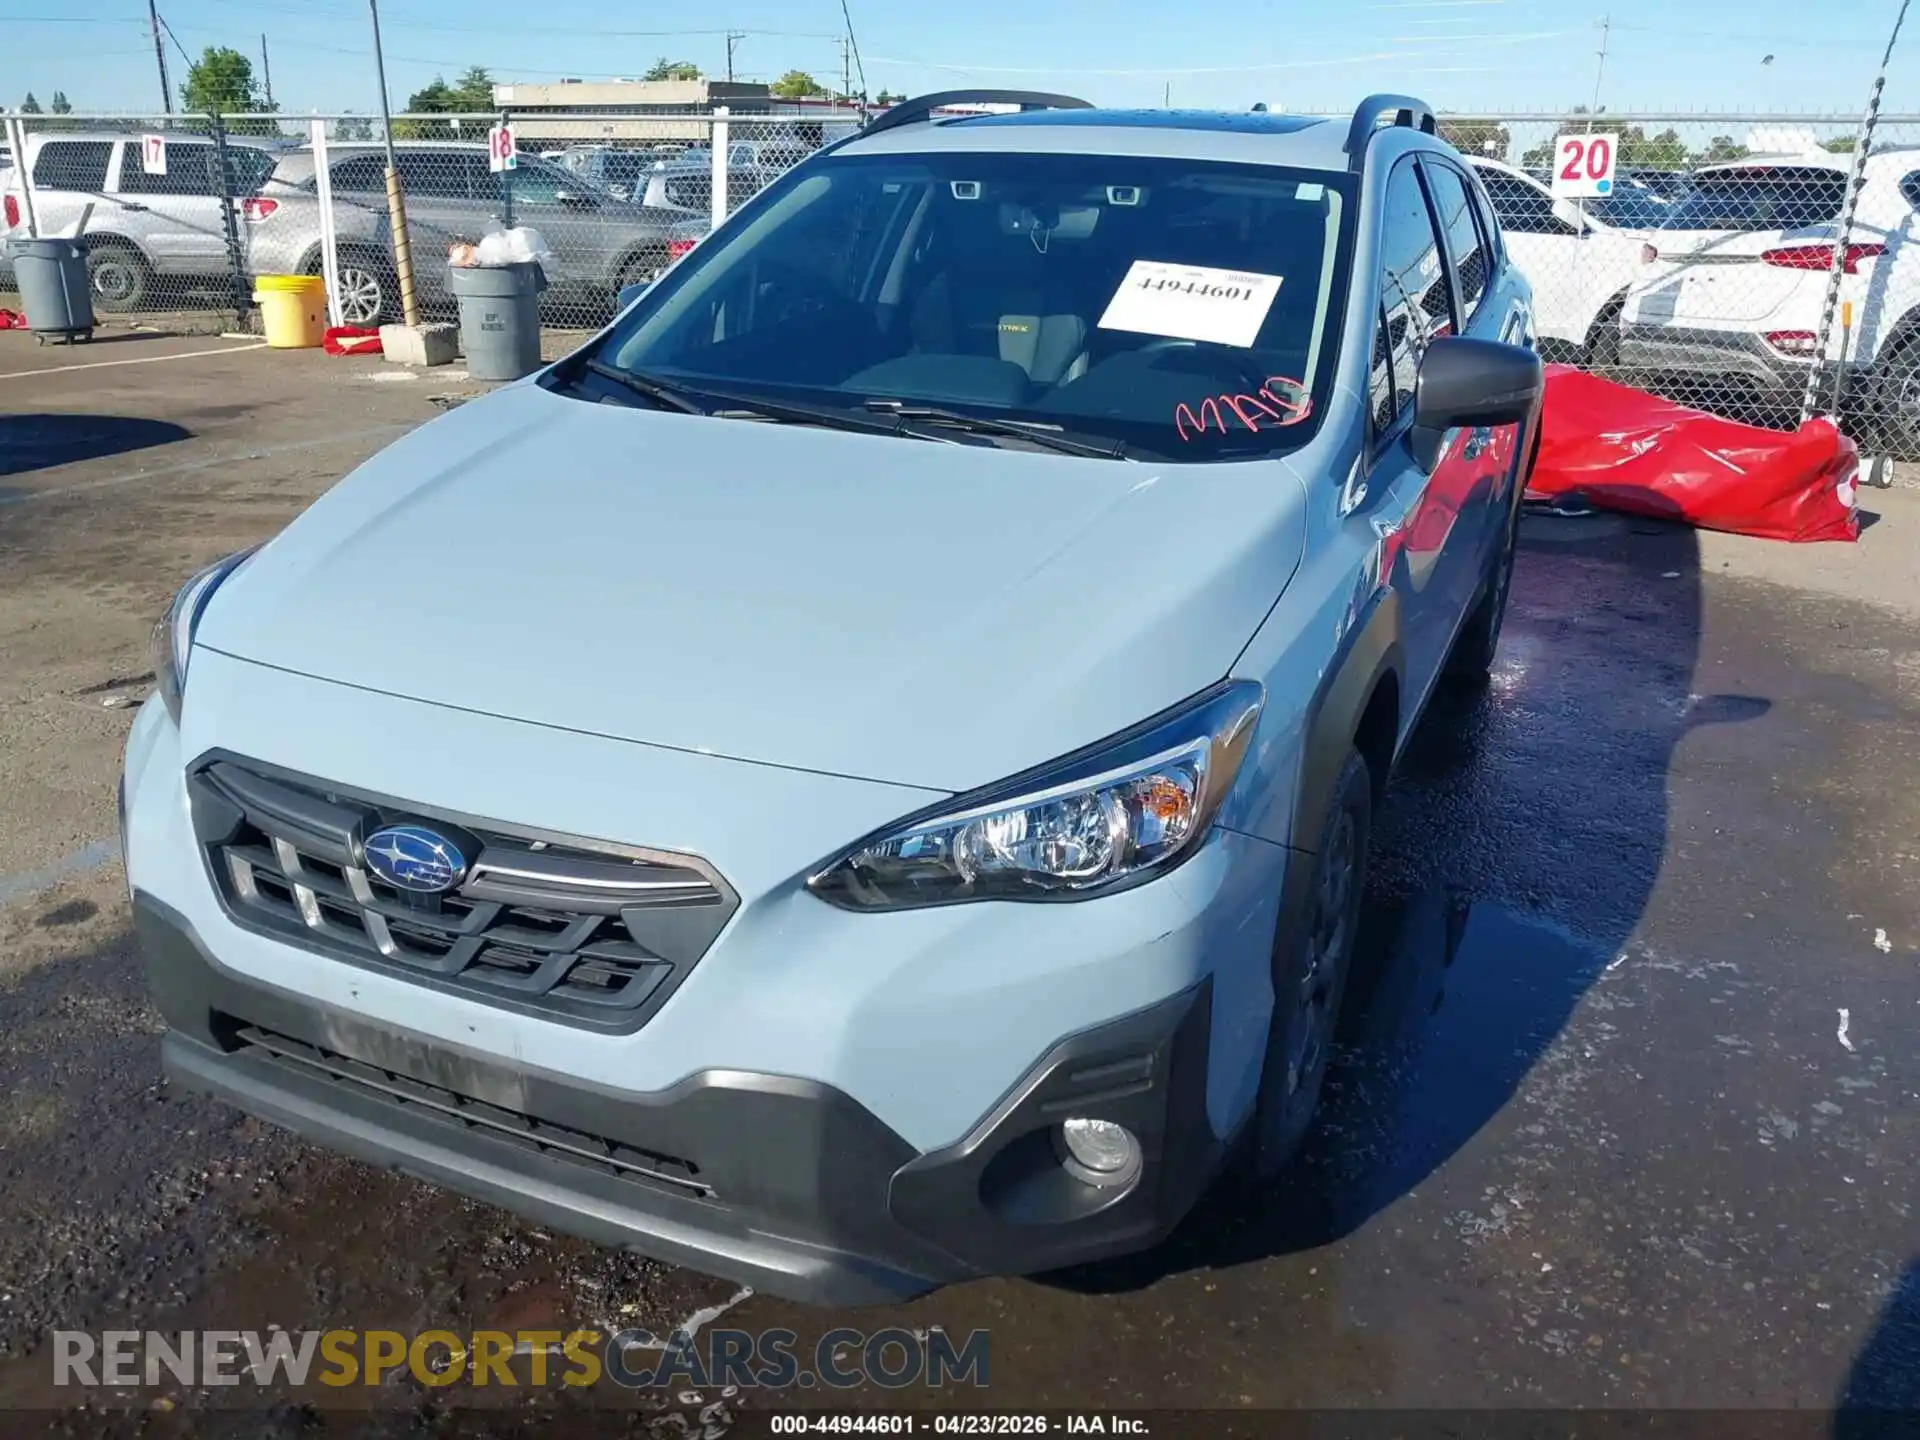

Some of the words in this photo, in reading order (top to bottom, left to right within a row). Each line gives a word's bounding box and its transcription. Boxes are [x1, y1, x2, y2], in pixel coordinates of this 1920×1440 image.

[145, 138, 161, 164] 17
[492, 127, 511, 159] 18
[1560, 138, 1610, 180] 20
[1136, 278, 1252, 301] 44944601
